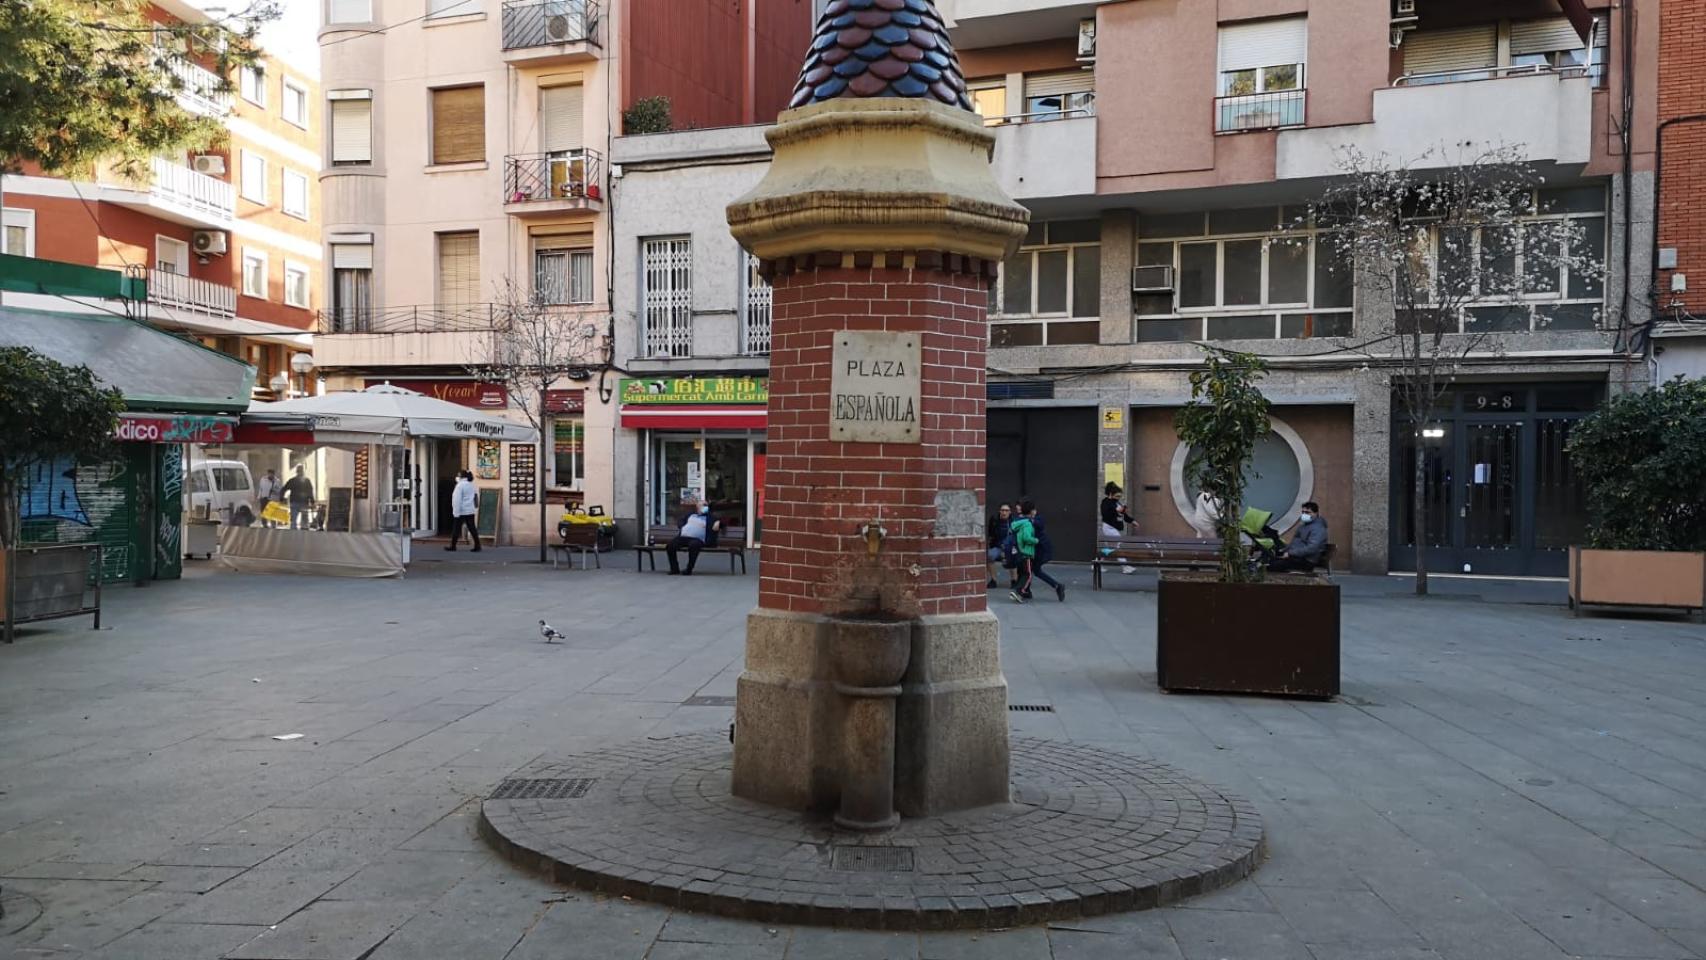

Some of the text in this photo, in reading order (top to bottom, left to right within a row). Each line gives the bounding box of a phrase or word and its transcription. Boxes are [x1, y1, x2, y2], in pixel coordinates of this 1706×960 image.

[847, 360, 905, 377] PLAZA
[623, 392, 701, 403] Supermercat
[706, 391, 734, 401] Amb
[836, 392, 916, 422] ESPAÑOLA
[454, 421, 505, 436] Bar Mozart
